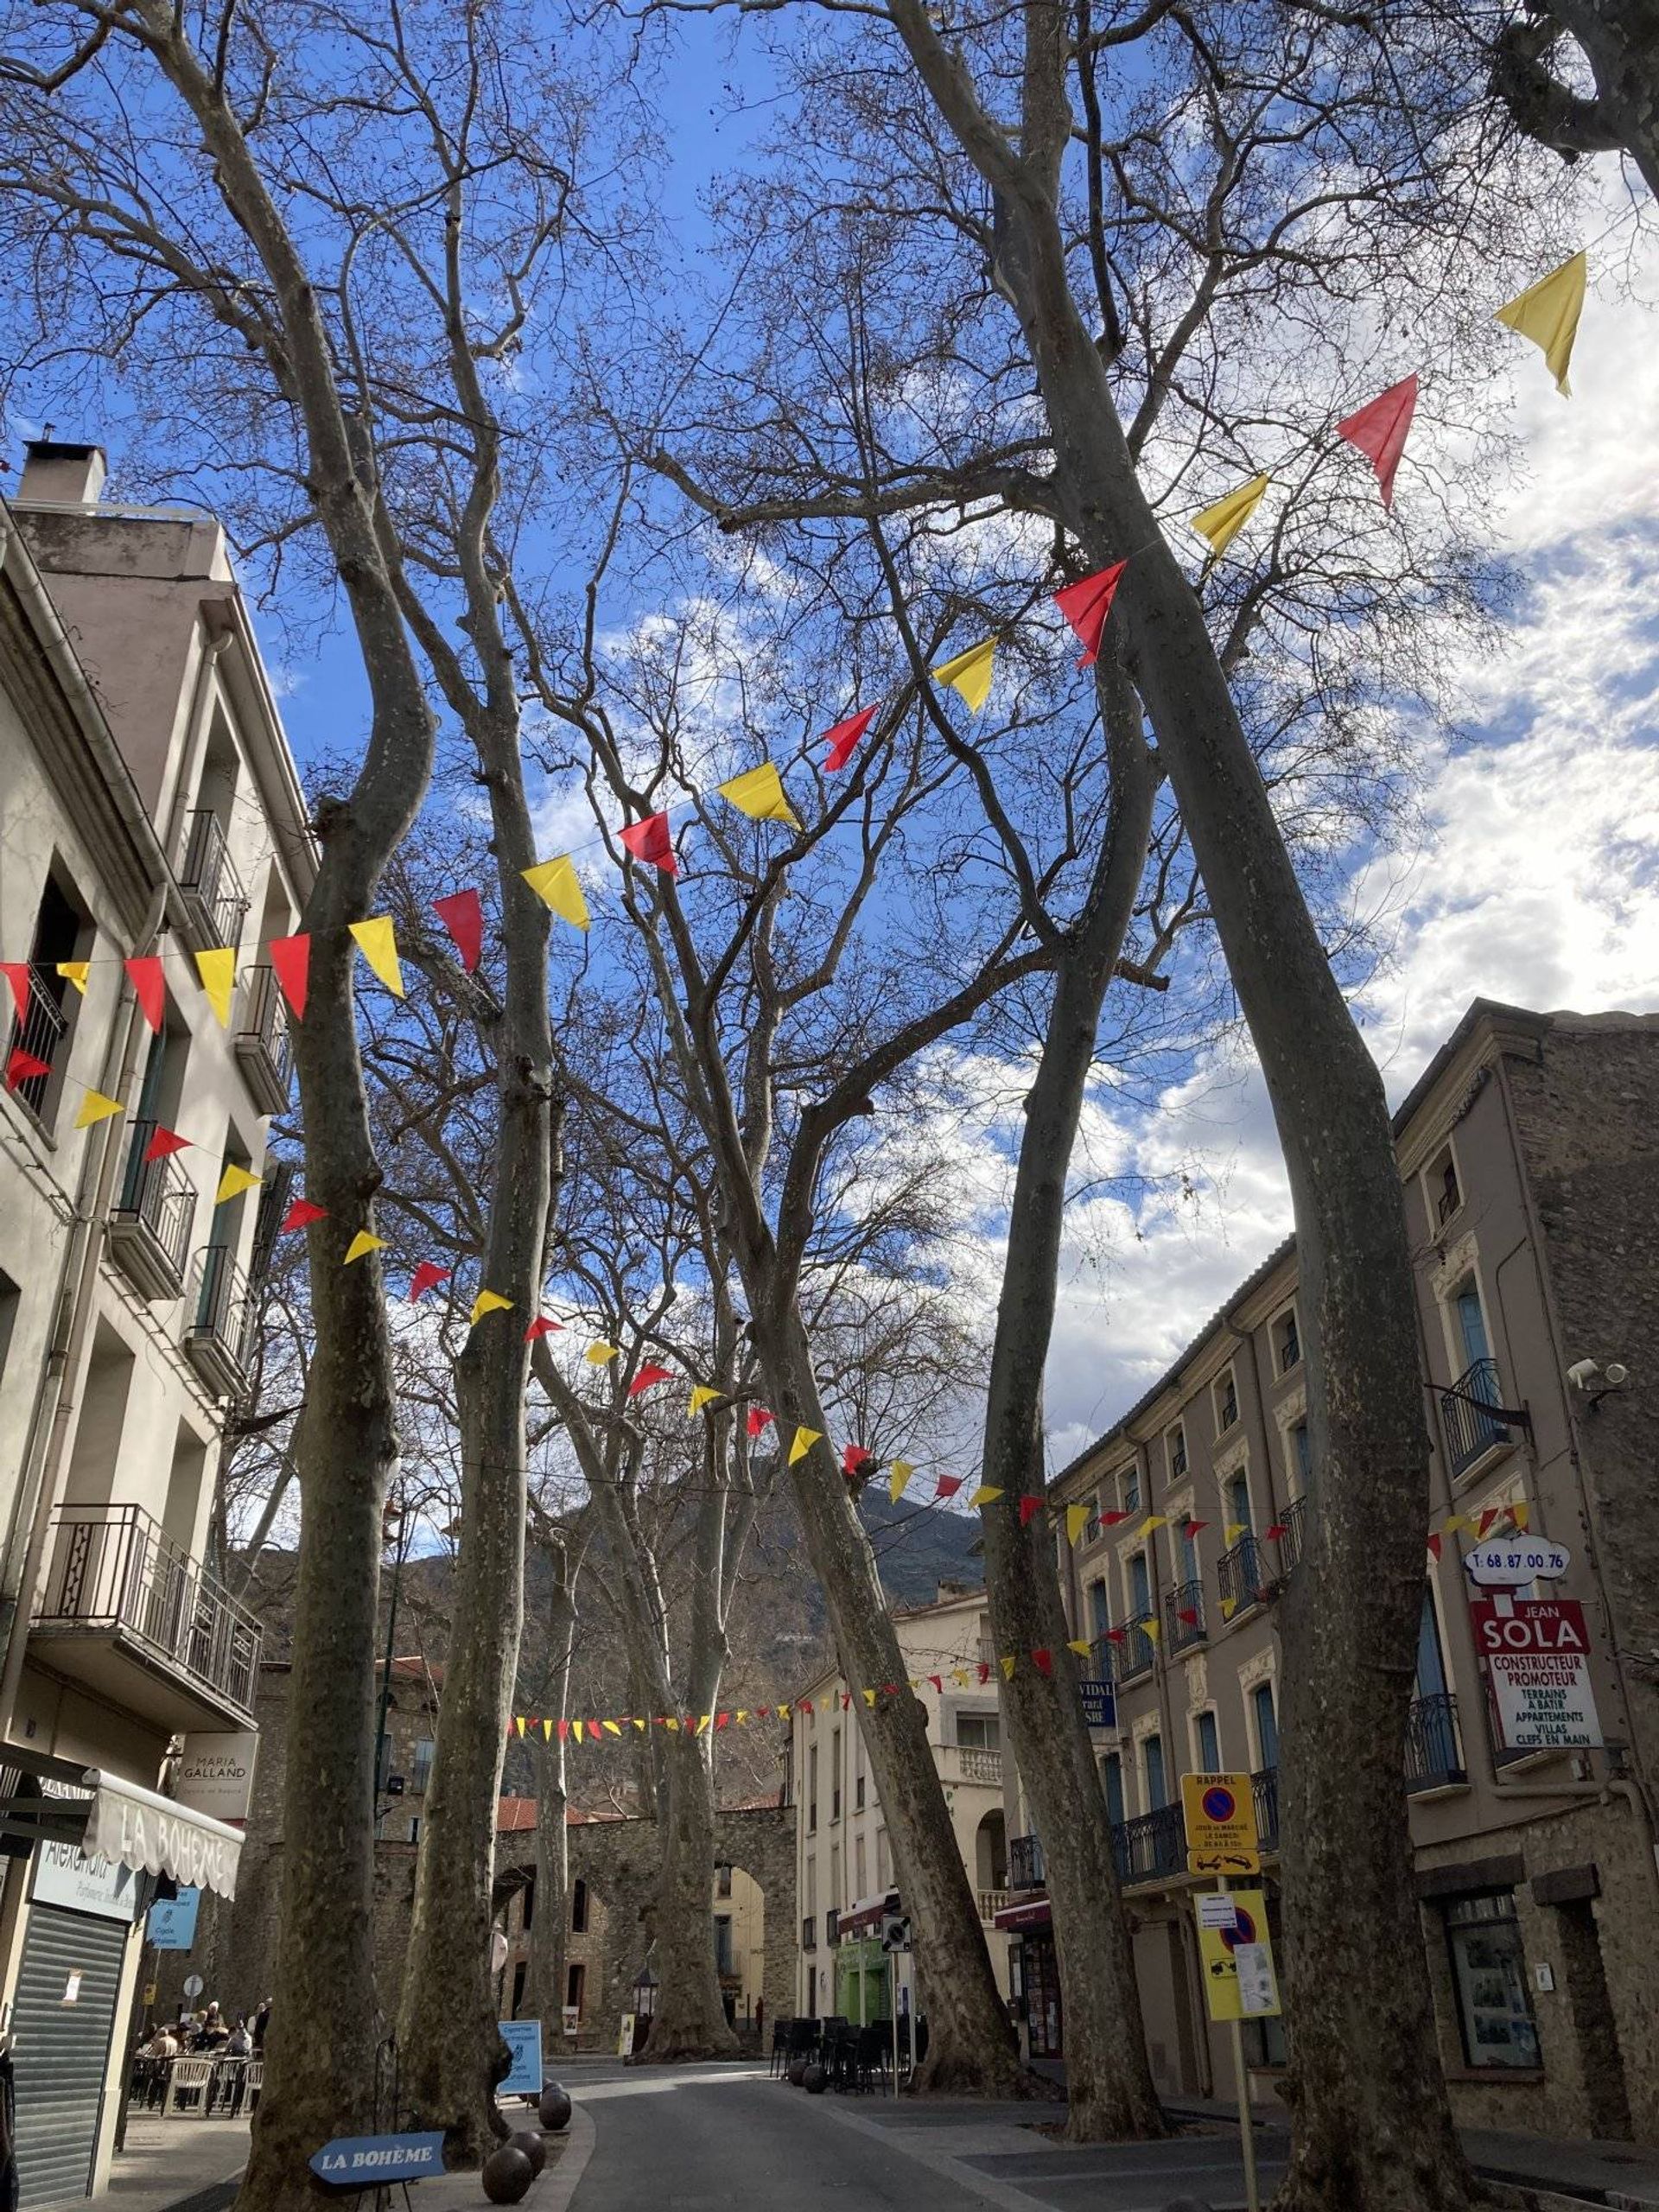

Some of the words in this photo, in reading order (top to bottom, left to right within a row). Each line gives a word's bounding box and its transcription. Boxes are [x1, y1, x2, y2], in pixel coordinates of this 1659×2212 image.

[1524, 1606, 1560, 1618] JEAN
[1483, 1619, 1583, 1649] SOLA
[1494, 1656, 1583, 1670] CONSTRUCTEUR
[1507, 1672, 1578, 1686] PROMOTEUR
[1079, 1684, 1113, 1696] VIDAL
[1522, 1689, 1567, 1700] TERRAINS
[1537, 1700, 1566, 1710] BATIR
[1516, 1712, 1584, 1722] APPARTEMENTS
[1535, 1724, 1567, 1733] VILLAS
[1516, 1734, 1542, 1745] CLEFS
[1546, 1734, 1559, 1744] EN
[1563, 1734, 1591, 1744] MAIN
[196, 1758, 236, 1767] MARIA
[184, 1768, 245, 1777] GALLAND
[1197, 1776, 1236, 1785] RAPPEL
[321, 2155, 347, 2170] LA
[352, 2144, 434, 2168] BOHÈME
